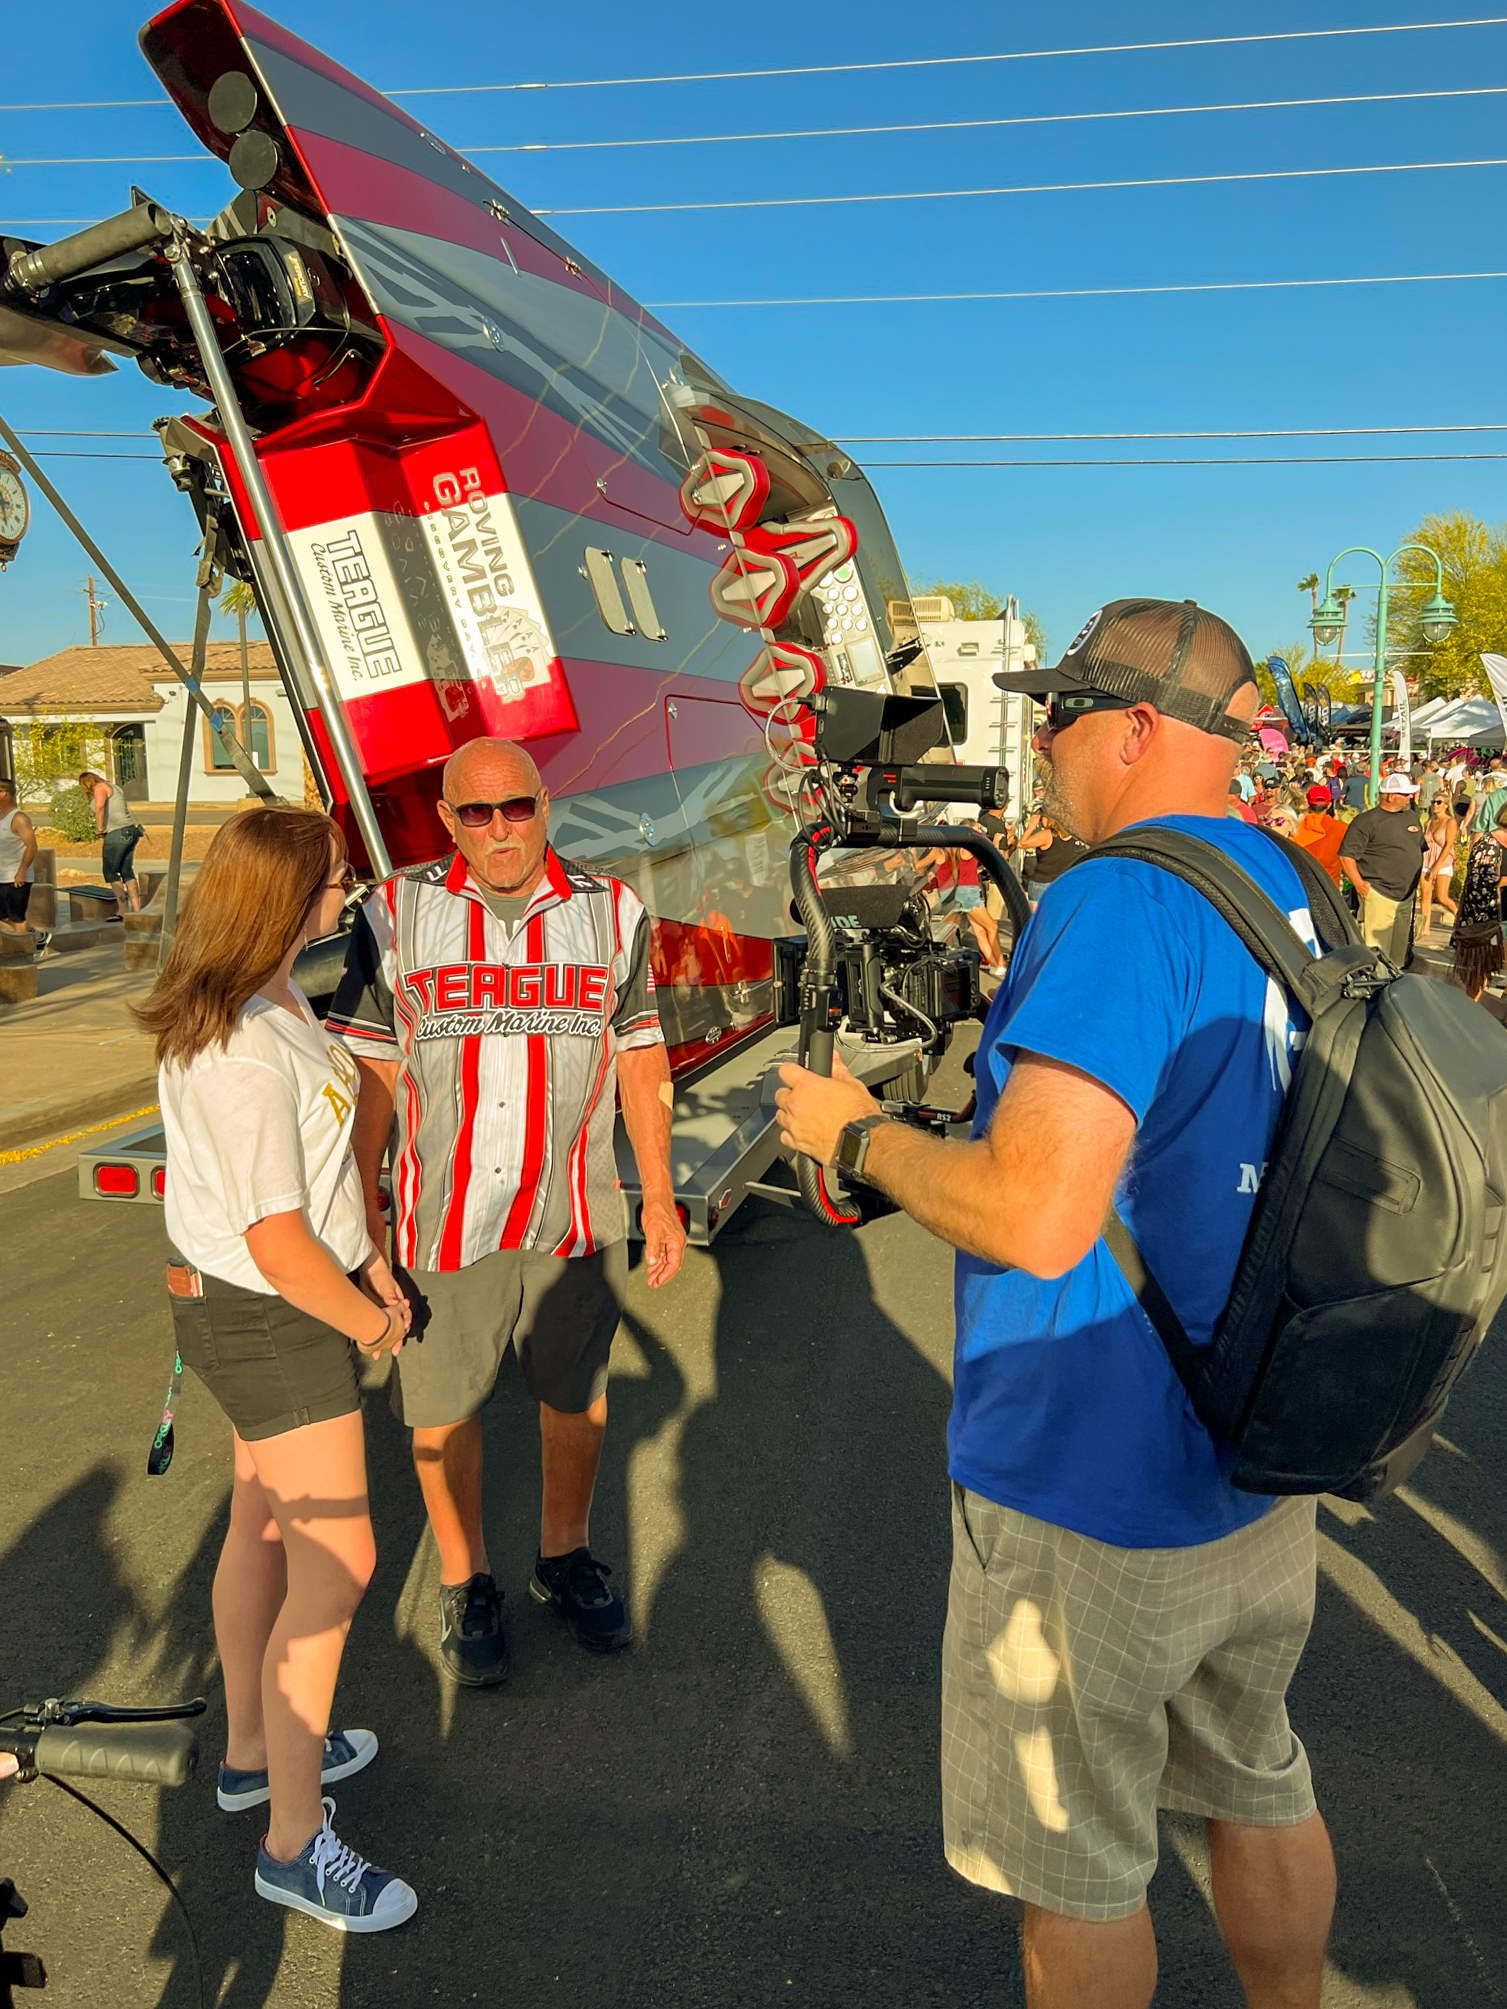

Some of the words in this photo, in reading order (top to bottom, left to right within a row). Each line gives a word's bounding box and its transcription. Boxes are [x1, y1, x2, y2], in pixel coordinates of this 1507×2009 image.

[424, 501, 462, 608] DISCOVERY
[433, 472, 526, 704] GAMBLER
[459, 466, 514, 597] ROVING
[310, 542, 336, 598] Custom
[328, 599, 356, 653] Marine
[346, 655, 363, 681] Inc.
[326, 529, 402, 679] TEAGUE
[402, 962, 609, 1015] TEAGUE
[415, 1014, 484, 1040] Custom
[485, 1011, 569, 1036] Marine
[569, 1014, 601, 1037] Inc.
